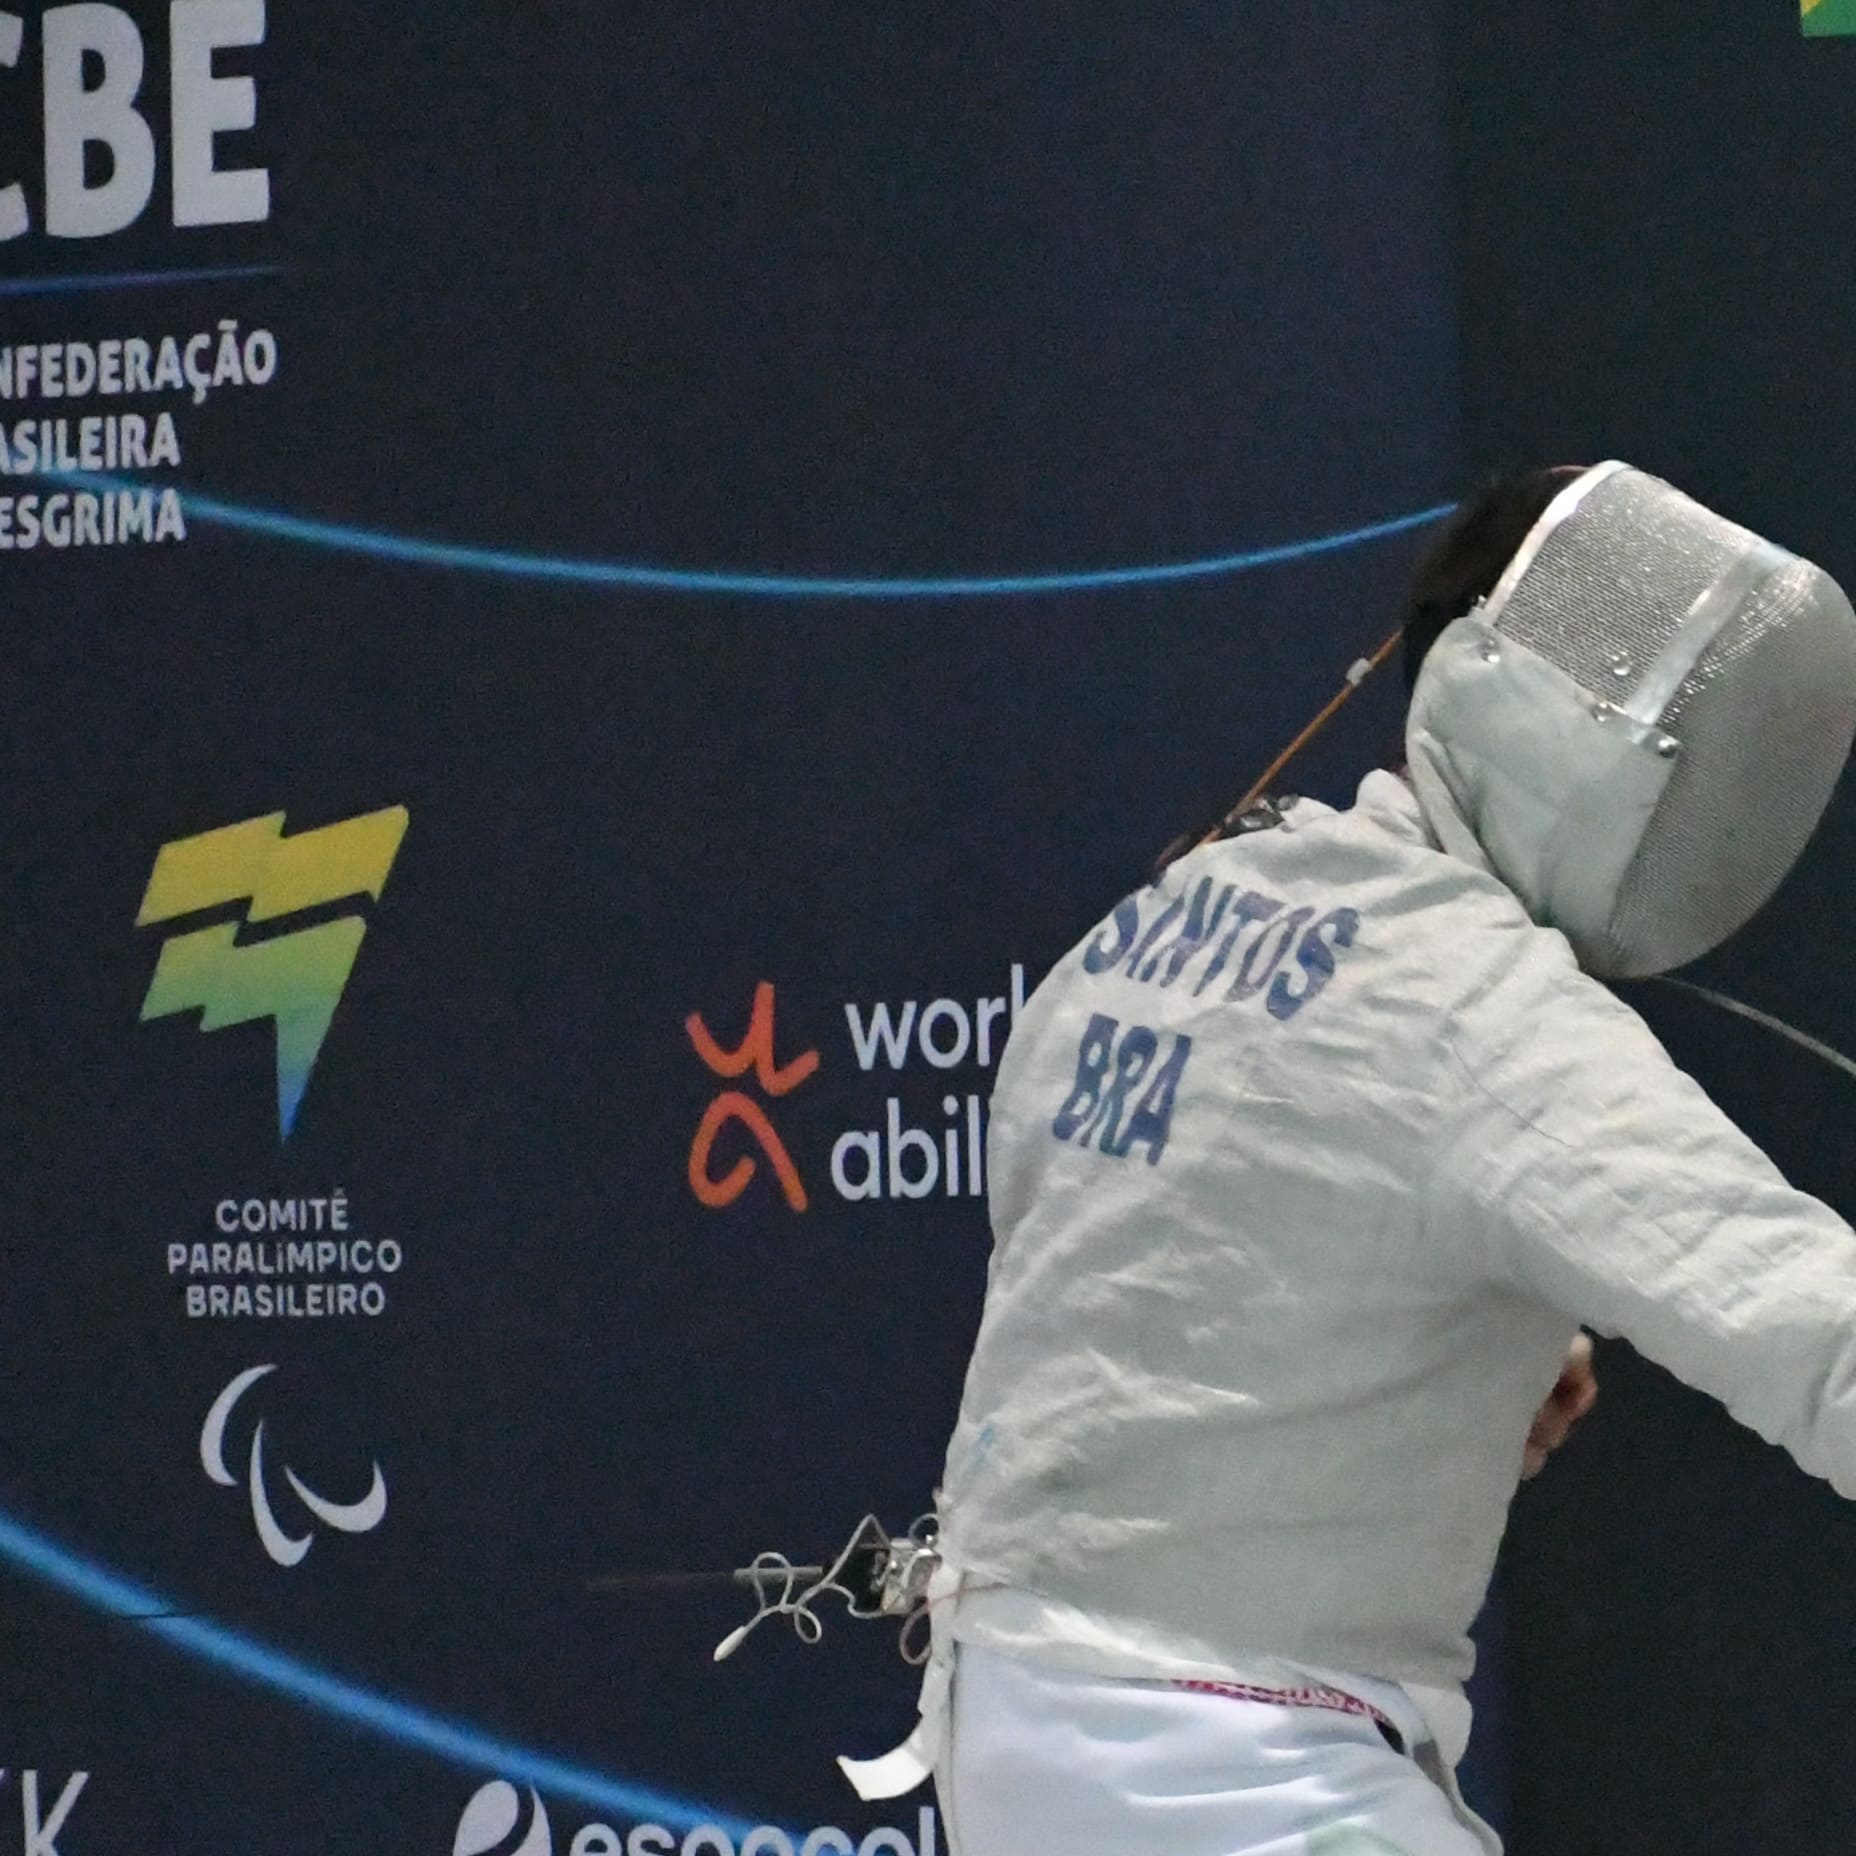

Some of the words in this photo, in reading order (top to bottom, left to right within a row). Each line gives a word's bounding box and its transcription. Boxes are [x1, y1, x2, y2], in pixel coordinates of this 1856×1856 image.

[0, 0, 270, 241] BE
[1053, 1013, 1192, 1166] BRA
[215, 1187, 350, 1232] COMITÊ
[186, 1281, 386, 1318] BRASILEIRO
